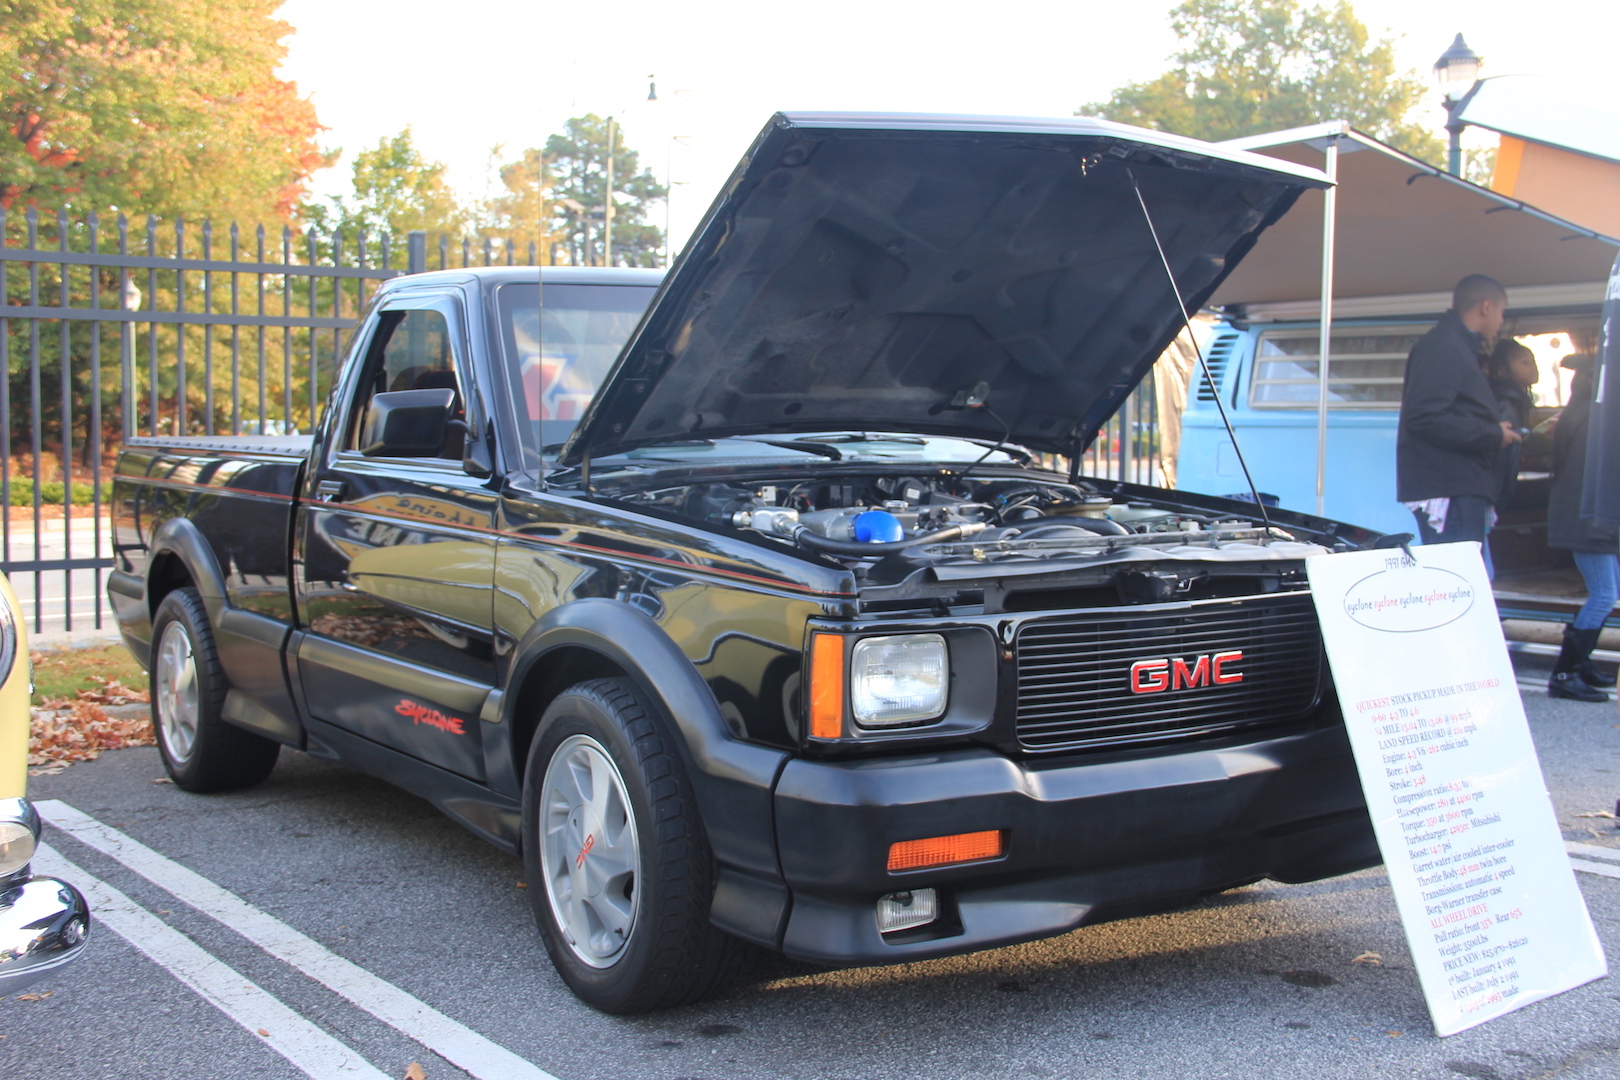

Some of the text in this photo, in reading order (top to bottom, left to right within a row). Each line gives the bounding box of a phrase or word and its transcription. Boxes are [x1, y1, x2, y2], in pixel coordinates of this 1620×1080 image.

[1385, 557, 1399, 569] 1991
[1348, 587, 1470, 615] syclone syclone syclone syclone syclone
[1130, 650, 1243, 694] GMC
[1356, 678, 1500, 713] QUICKEST STOCK PICKUP MADE IN THE WORLD
[1382, 723, 1400, 734] MILE
[1417, 718, 1427, 728] TO
[1458, 710, 1472, 721] mph
[1398, 708, 1408, 718] TO
[1378, 738, 1397, 750] LAND
[1398, 734, 1419, 746] SPEED
[1419, 728, 1446, 741] RECORD
[1464, 722, 1477, 733] mph
[1382, 753, 1406, 764] Engine:
[1416, 747, 1426, 755] V6
[1440, 742, 1455, 751] cubic
[1456, 738, 1469, 748] inch
[1385, 768, 1403, 777] Bore:
[1408, 761, 1423, 772] inch
[1389, 779, 1412, 791] Stroke:
[1393, 789, 1433, 805] Compression
[1471, 791, 1484, 801] rpm
[1400, 820, 1425, 832] Torque:
[1461, 808, 1474, 818] rpm
[1404, 829, 1448, 845] Turbocharger:
[1470, 812, 1501, 828] Mitsubishi
[1408, 848, 1429, 860] Boost:
[1442, 840, 1452, 853] psi
[1462, 846, 1482, 860] cooled
[1416, 872, 1442, 887] Throttle
[1479, 860, 1493, 869] twin
[1492, 856, 1507, 865] bore
[1421, 883, 1464, 901] Transmission:
[1464, 873, 1493, 889] automatic
[1498, 865, 1515, 879] speed
[1425, 886, 1502, 915] Borg-Warner transfer case
[1431, 903, 1488, 929] ALL WHEEL DRIVE
[1434, 931, 1448, 943] Pull
[1447, 927, 1465, 939] ratio:
[1464, 922, 1480, 933] front
[1495, 913, 1509, 923] Rear
[1438, 943, 1463, 957] Weight:
[1442, 957, 1463, 972] PRICE
[1463, 952, 1481, 963] NEW:
[1454, 970, 1472, 983] built:
[1472, 964, 1496, 977] January
[1502, 956, 1516, 966] 1991
[1452, 986, 1469, 1000] LAST
[1468, 981, 1485, 994] built:
[1486, 976, 1498, 988] July
[1505, 971, 1519, 981] 1991
[1501, 984, 1519, 998] made
